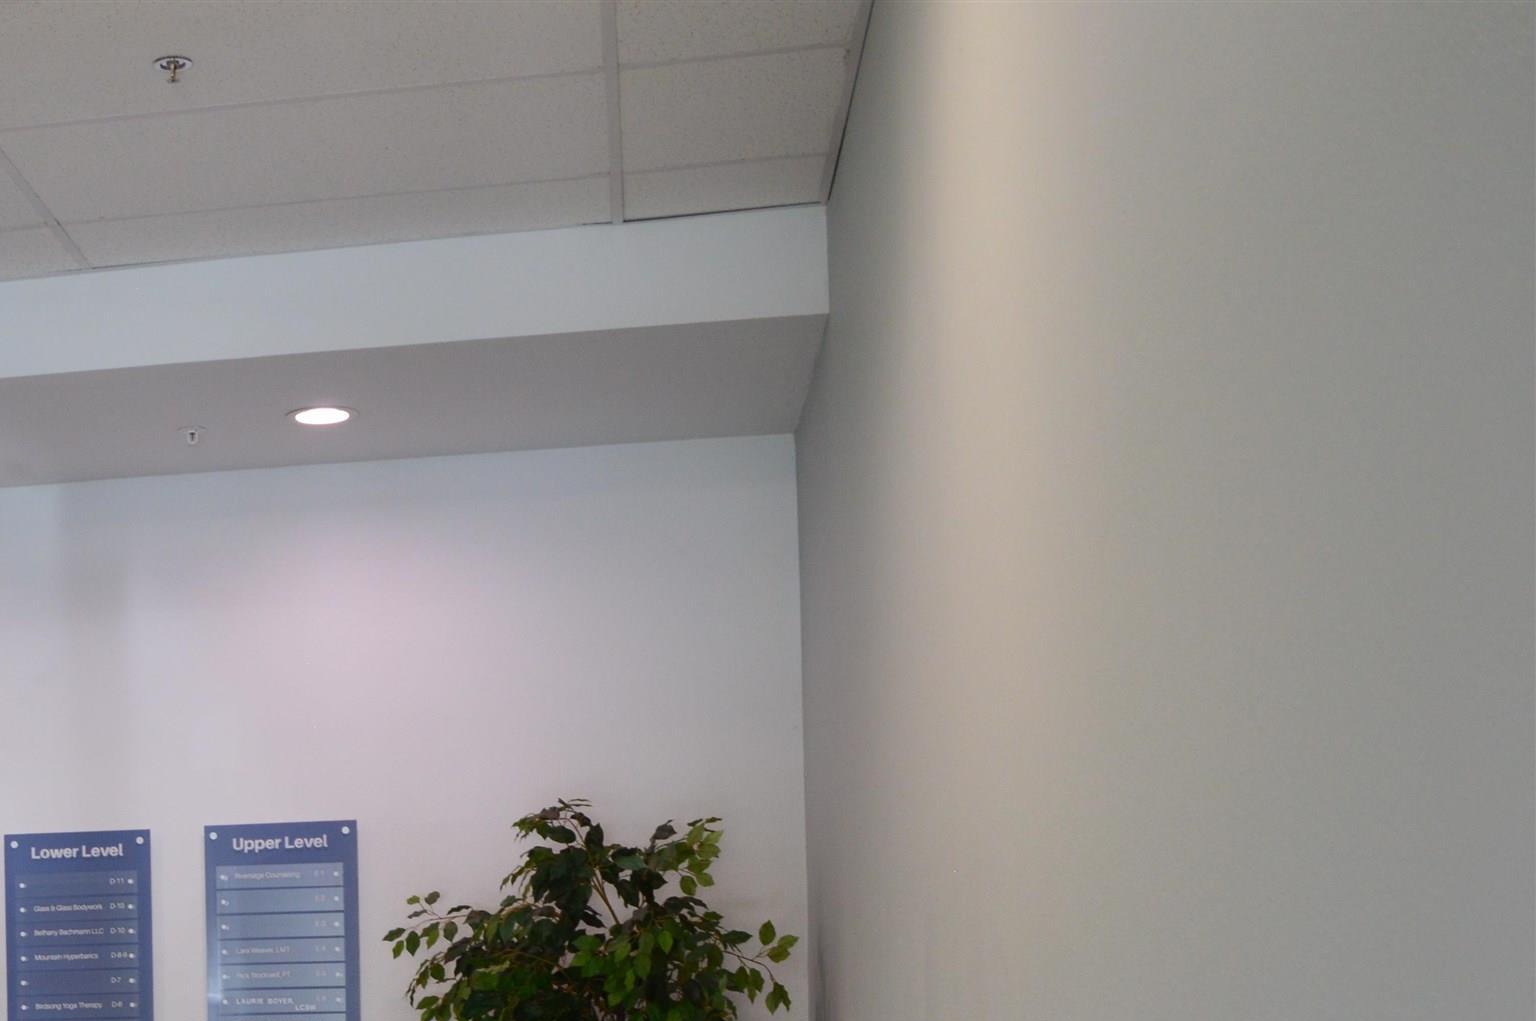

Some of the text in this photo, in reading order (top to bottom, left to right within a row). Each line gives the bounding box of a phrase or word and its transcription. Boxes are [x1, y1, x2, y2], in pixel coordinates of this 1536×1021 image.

[232, 834, 328, 853] Upper Level
[31, 843, 124, 859] Lower Level
[109, 877, 124, 885] D-11
[72, 903, 103, 912] Bodywork
[33, 928, 58, 937] Bethany
[91, 927, 104, 935] LLC
[109, 927, 126, 935] D-10
[62, 1002, 78, 1010] Yoga
[78, 1001, 103, 1009] Therapy
[235, 997, 264, 1005] LAURIE
